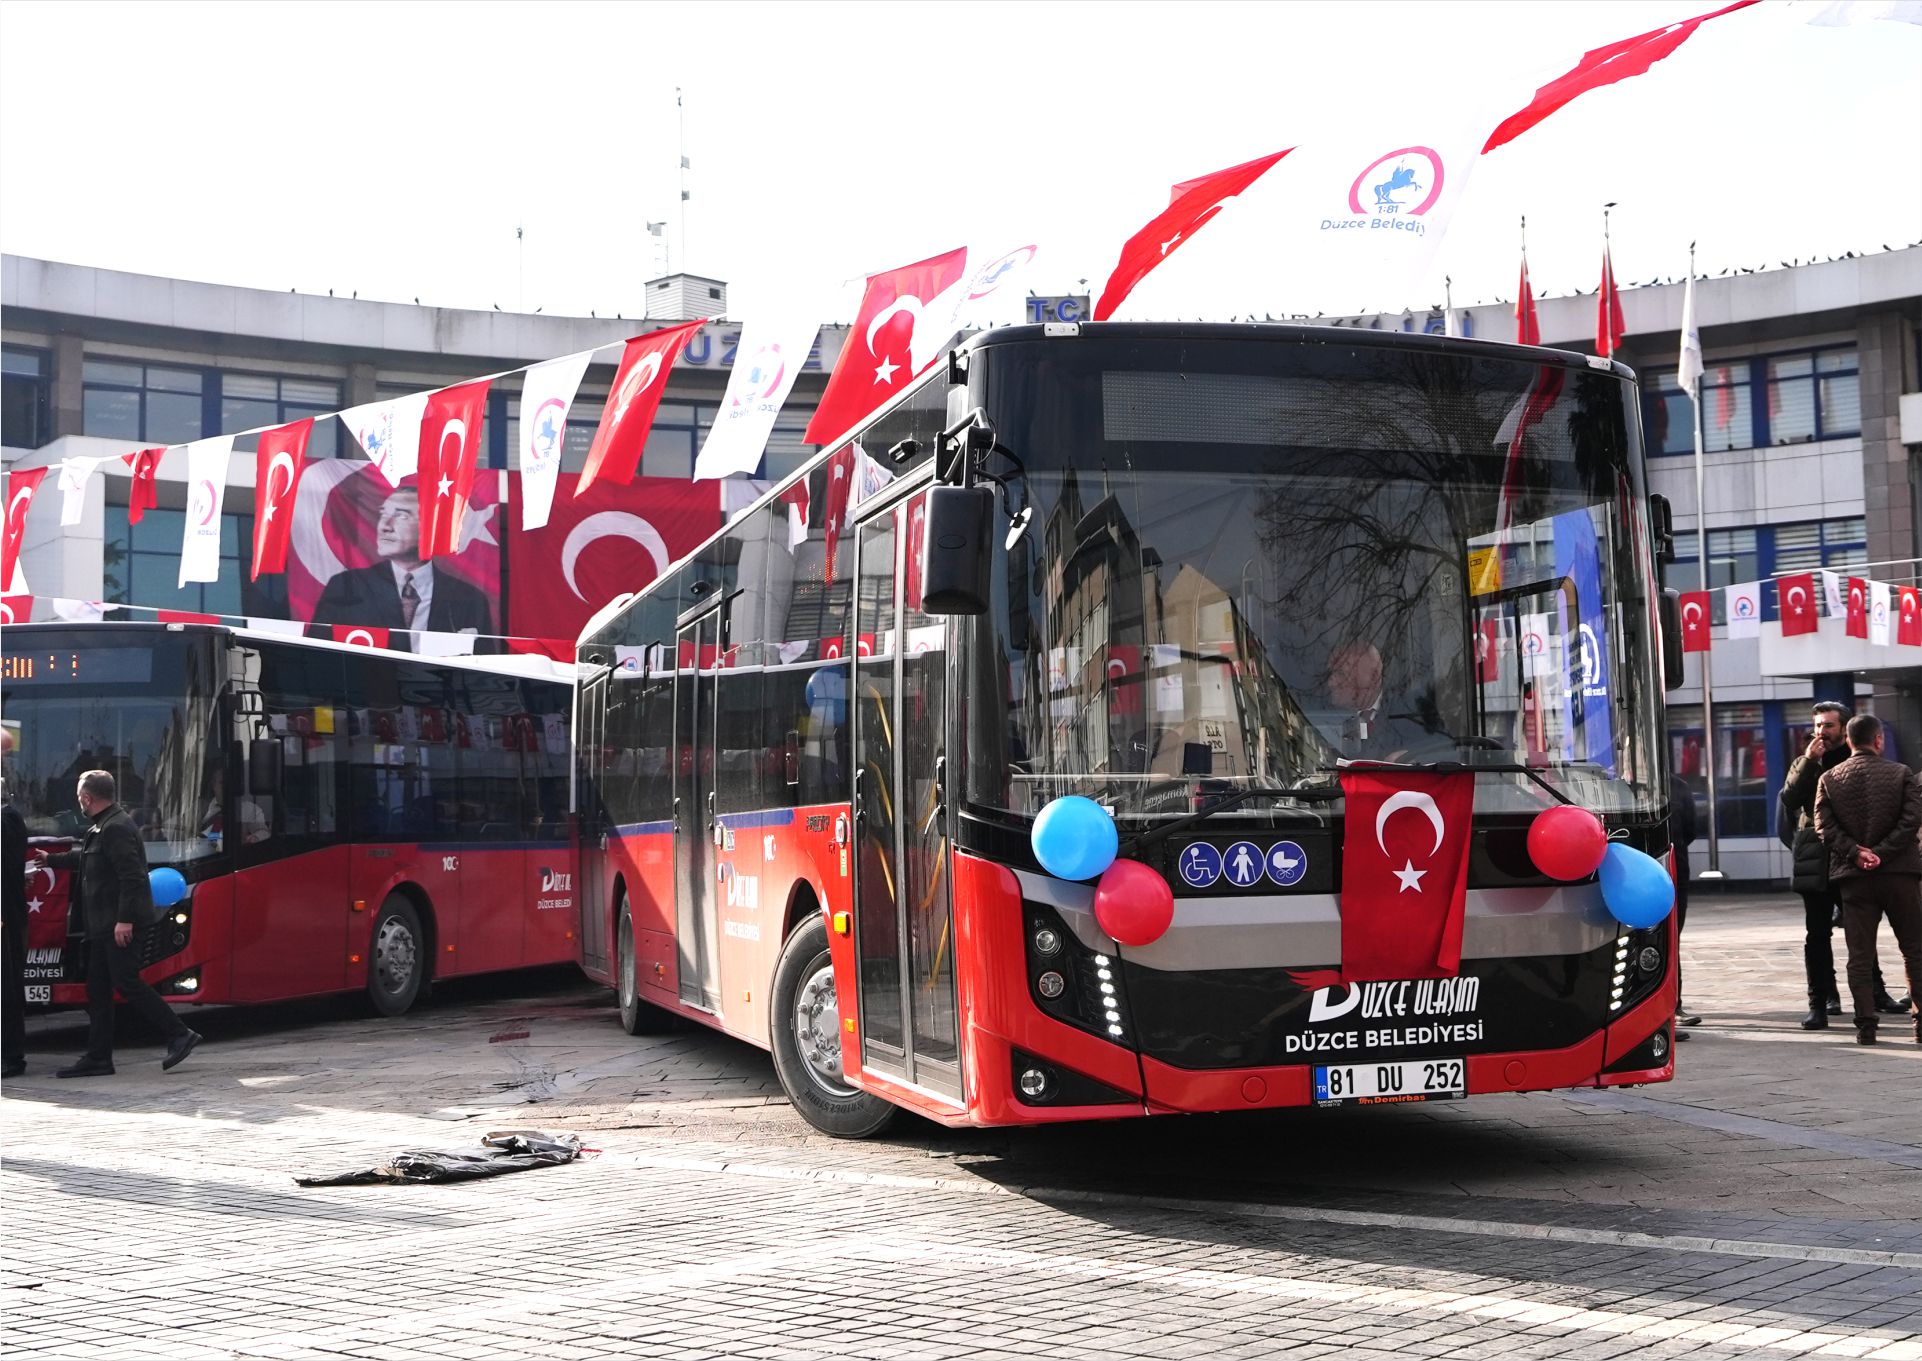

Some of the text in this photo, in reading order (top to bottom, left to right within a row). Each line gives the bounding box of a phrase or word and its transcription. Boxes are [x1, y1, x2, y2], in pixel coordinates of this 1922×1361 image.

[29, 987, 49, 1000] 545
[1285, 1019, 1484, 1053] DÜZCE BELEDİYESİ
[1317, 1085, 1327, 1094] TR
[1330, 1062, 1462, 1095] 81 DU 252
